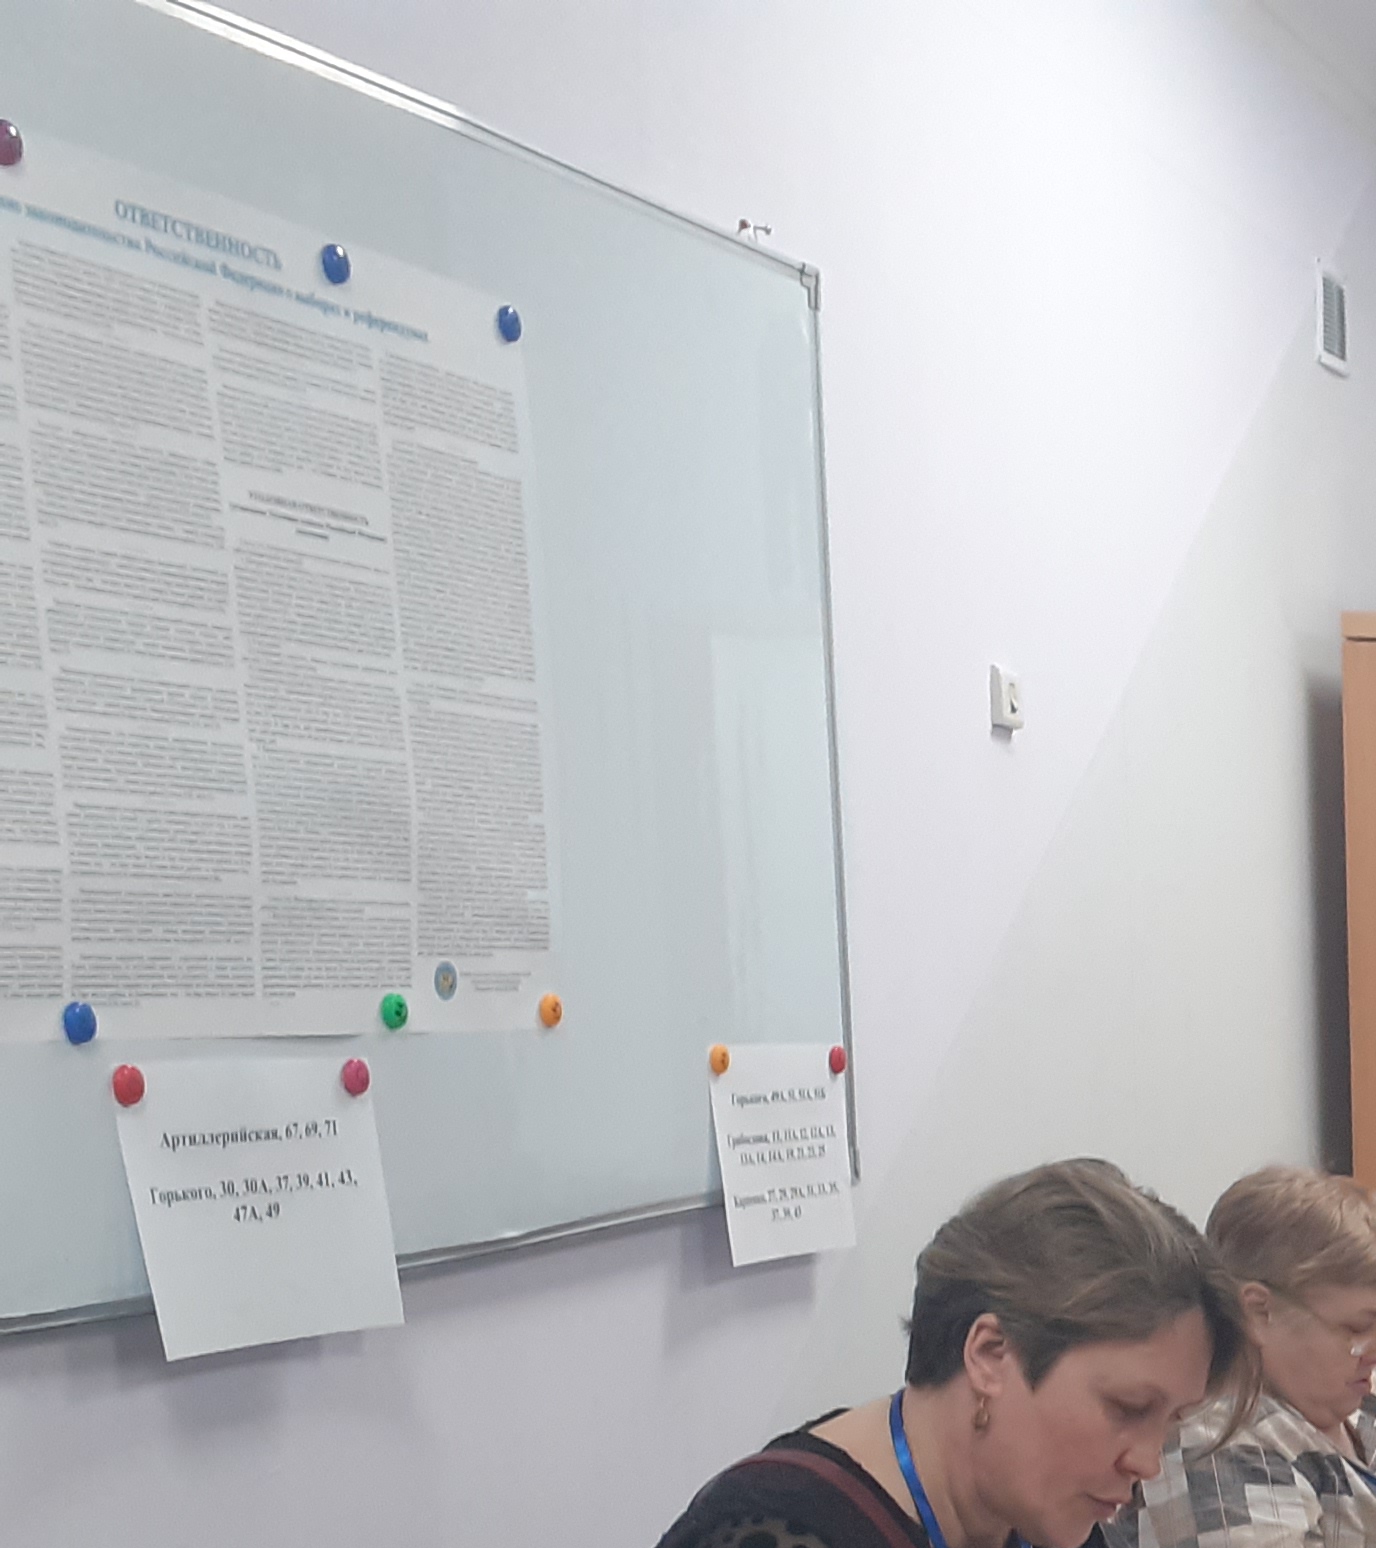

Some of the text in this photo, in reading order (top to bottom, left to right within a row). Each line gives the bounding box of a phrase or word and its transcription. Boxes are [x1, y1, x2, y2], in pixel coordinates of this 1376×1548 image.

[114, 199, 283, 271] ОТВЕТСТВЕННОСТЬ
[160, 1119, 338, 1152] Артиллерийская, 67, 69, 71
[150, 1169, 358, 1207] Горького, 30, 30А, 37, 39, 41, 43,
[233, 1202, 280, 1223] 47А, 49
